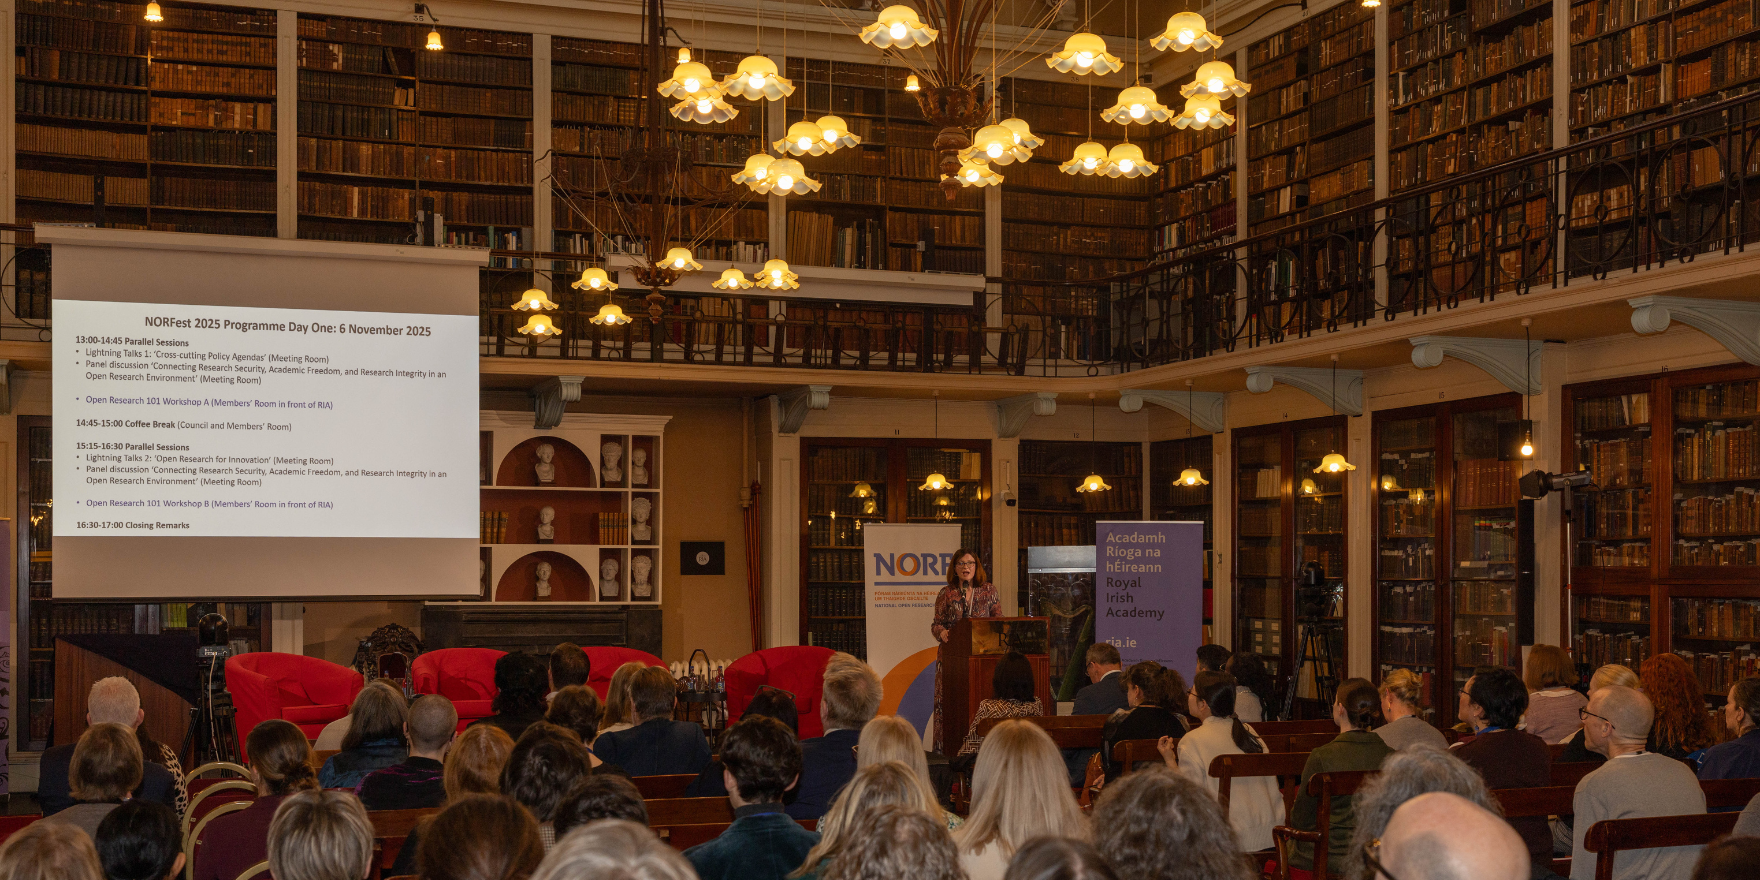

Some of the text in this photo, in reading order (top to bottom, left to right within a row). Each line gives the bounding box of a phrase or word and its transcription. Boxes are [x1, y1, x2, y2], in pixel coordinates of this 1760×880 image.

[145, 316, 431, 336] NORFest 2025 Programme Day One: 6 November 2025
[75, 335, 189, 346] 13:00-14:45 Parallel Sessions
[85, 348, 121, 358] Lightning
[122, 349, 142, 357] Talks
[207, 351, 230, 361] Policy
[268, 354, 302, 364] (Meeting
[304, 355, 329, 364] Room)
[85, 359, 107, 368] Panel
[108, 360, 148, 369] discussion
[234, 364, 266, 374] Security,
[268, 365, 305, 373] Academic
[307, 366, 342, 376] Freedom,
[360, 368, 393, 376] Research
[395, 369, 426, 378] Integrity
[85, 371, 107, 380] Open
[109, 372, 144, 380] Research
[199, 374, 234, 384] (Meeting
[236, 375, 261, 385] Room)
[85, 395, 107, 404] Open
[109, 396, 144, 404] Research
[162, 397, 202, 406] Workshop
[317, 401, 333, 410] RIA)
[76, 418, 123, 427] 14:45-15:00
[124, 419, 150, 427] Coffee
[152, 420, 175, 428] Break
[177, 420, 208, 429] (Council
[266, 422, 291, 431] Room)
[76, 441, 190, 451] 15:15-16:30 Parallel Sessions
[86, 453, 122, 463] Lightning
[123, 453, 142, 462] Talks
[179, 454, 213, 463] Research
[215, 455, 226, 463] for
[273, 456, 307, 466] (Meeting
[309, 457, 334, 466] Room)
[86, 464, 108, 472] Panel
[109, 464, 149, 473] discussion
[198, 466, 233, 474] Research
[234, 467, 267, 476] Security,
[268, 467, 305, 475] Academic
[307, 468, 343, 477] Freedom,
[344, 468, 359, 476] and
[396, 469, 428, 479] Integrity
[86, 476, 107, 485] Open
[109, 476, 144, 485] Research
[200, 477, 235, 488] (Meeting
[236, 478, 262, 487] Room)
[86, 499, 108, 508] Open
[162, 499, 202, 508] Workshop
[287, 500, 306, 508] front
[307, 500, 316, 508] of
[317, 501, 333, 510] RIA)
[76, 521, 190, 530] 16:30-17:00 Closing Remarks
[1106, 532, 1166, 543] Acadamh
[1106, 546, 1160, 560] Ríoga na
[1106, 559, 1162, 572] hÉireann
[1106, 577, 1141, 590] Royal
[1106, 592, 1133, 603] Irish
[1106, 607, 1165, 621] Academy
